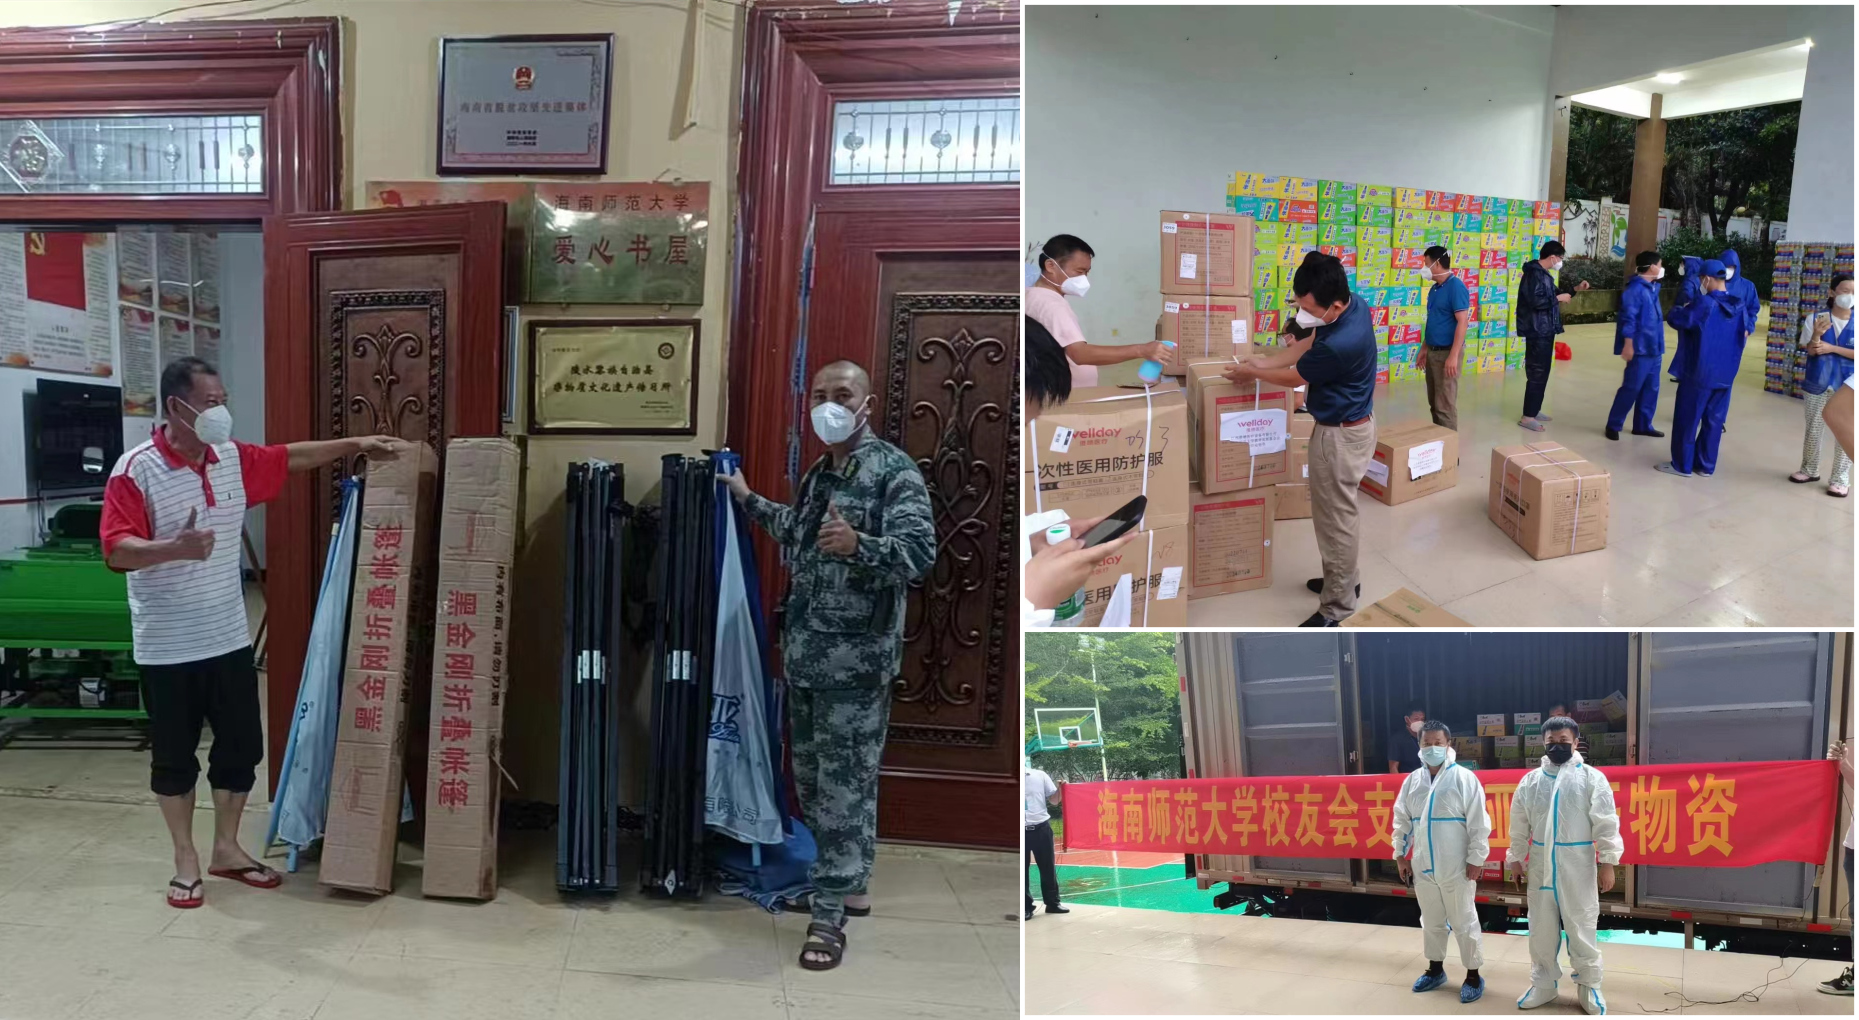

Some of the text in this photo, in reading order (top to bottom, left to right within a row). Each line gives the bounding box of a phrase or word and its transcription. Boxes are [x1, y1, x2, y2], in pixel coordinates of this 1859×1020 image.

[552, 233, 690, 265] 爱心书屋
[554, 193, 690, 212] 海南师范大学
[354, 524, 402, 733] 黑金刚折叠帐篷
[438, 589, 478, 810] 黑金刚折叠帐篷
